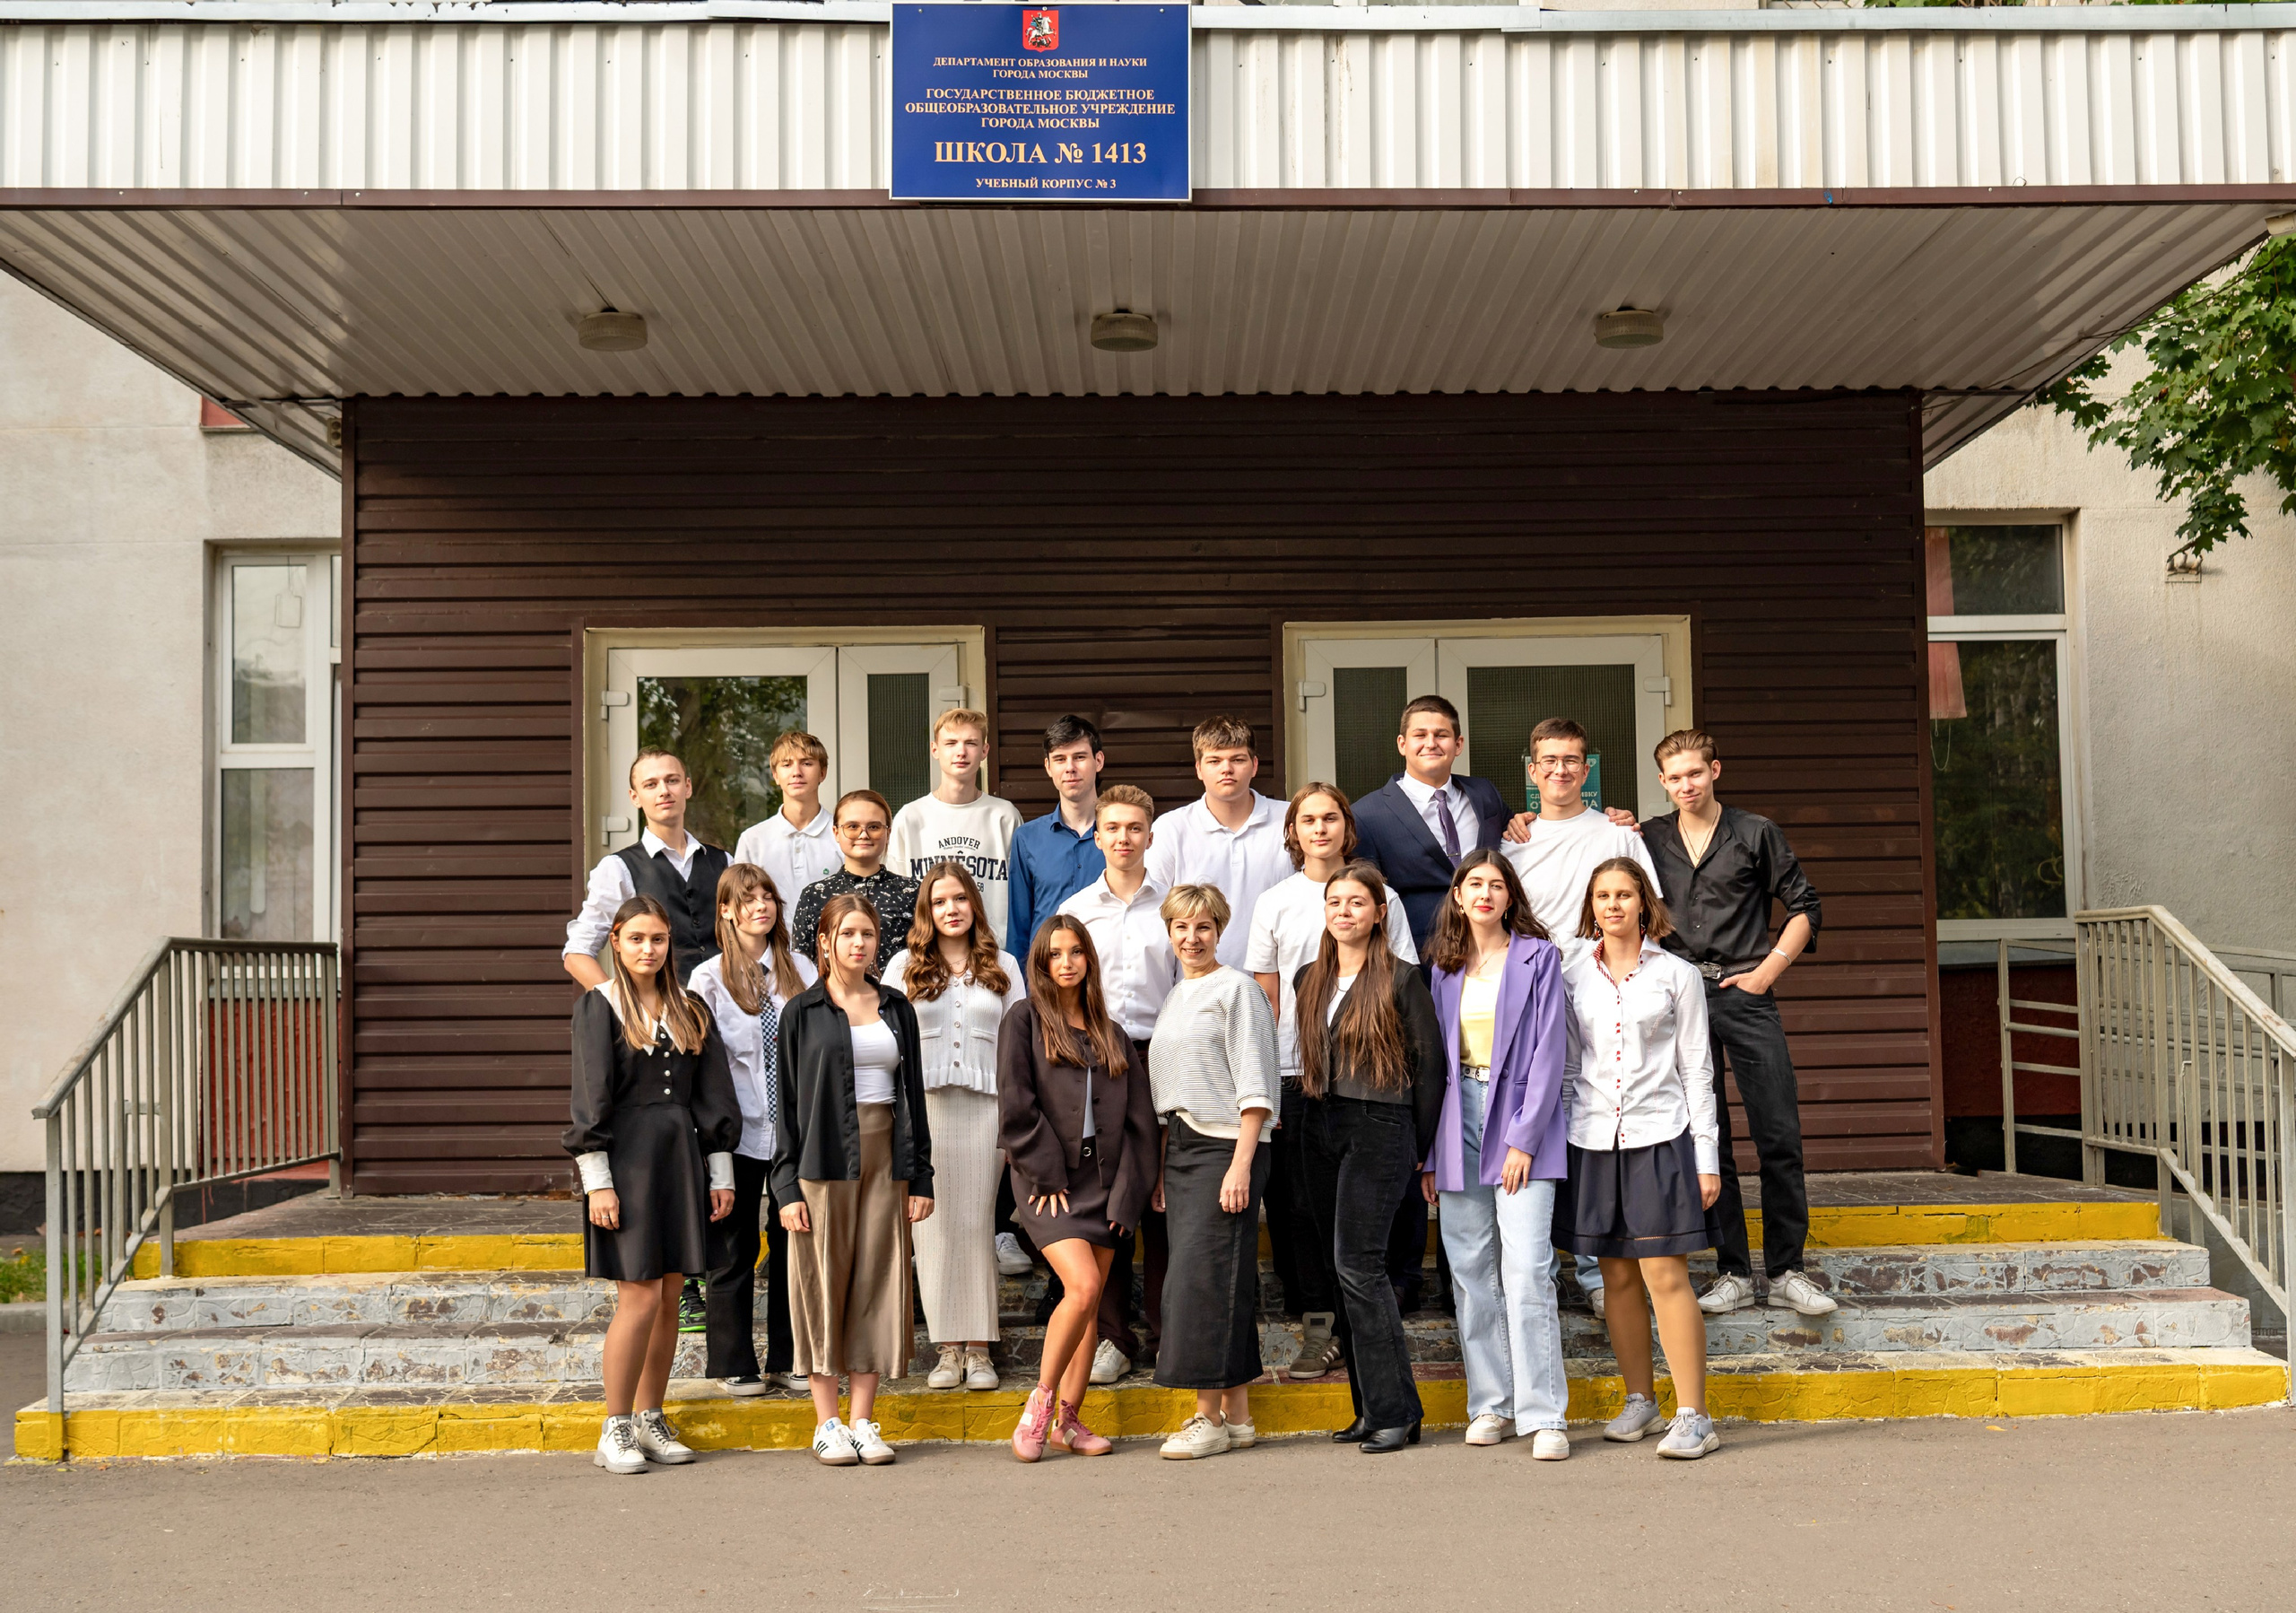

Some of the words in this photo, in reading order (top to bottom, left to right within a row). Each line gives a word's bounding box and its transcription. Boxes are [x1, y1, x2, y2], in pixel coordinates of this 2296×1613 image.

[933, 57, 1016, 67] ДЕПАРТАМЕНТ
[1017, 57, 1097, 68] ОБРАЗОВАНИЯ
[1098, 57, 1107, 67] И
[1109, 57, 1147, 67] НАУКИ
[993, 69, 1037, 80] ГОРОДА
[1038, 69, 1089, 79] МОСКВЫ
[926, 88, 1062, 101] ГОСУДАРСТВЕННОЕ
[1065, 89, 1155, 102] БЮДЖЕТНОЕ
[904, 101, 1078, 115] ОБЩЕОБРАЗОВАТЕЛЬНОЕ
[1080, 102, 1176, 116] УЧРЕЖДЕНИЕ
[981, 117, 1035, 130] ГОРОДА
[1038, 118, 1100, 129] МОСКВЫ
[934, 141, 1048, 164] ШКОЛА
[1054, 142, 1083, 164] №
[1091, 142, 1147, 164] 1413
[975, 176, 1039, 188] УЧЕБНЫЙ
[1041, 179, 1093, 189] КОРПУС
[1094, 179, 1109, 189] №
[1109, 179, 1117, 189] 3
[938, 836, 981, 850] ANDOVER
[909, 855, 1008, 881] MISOTA
